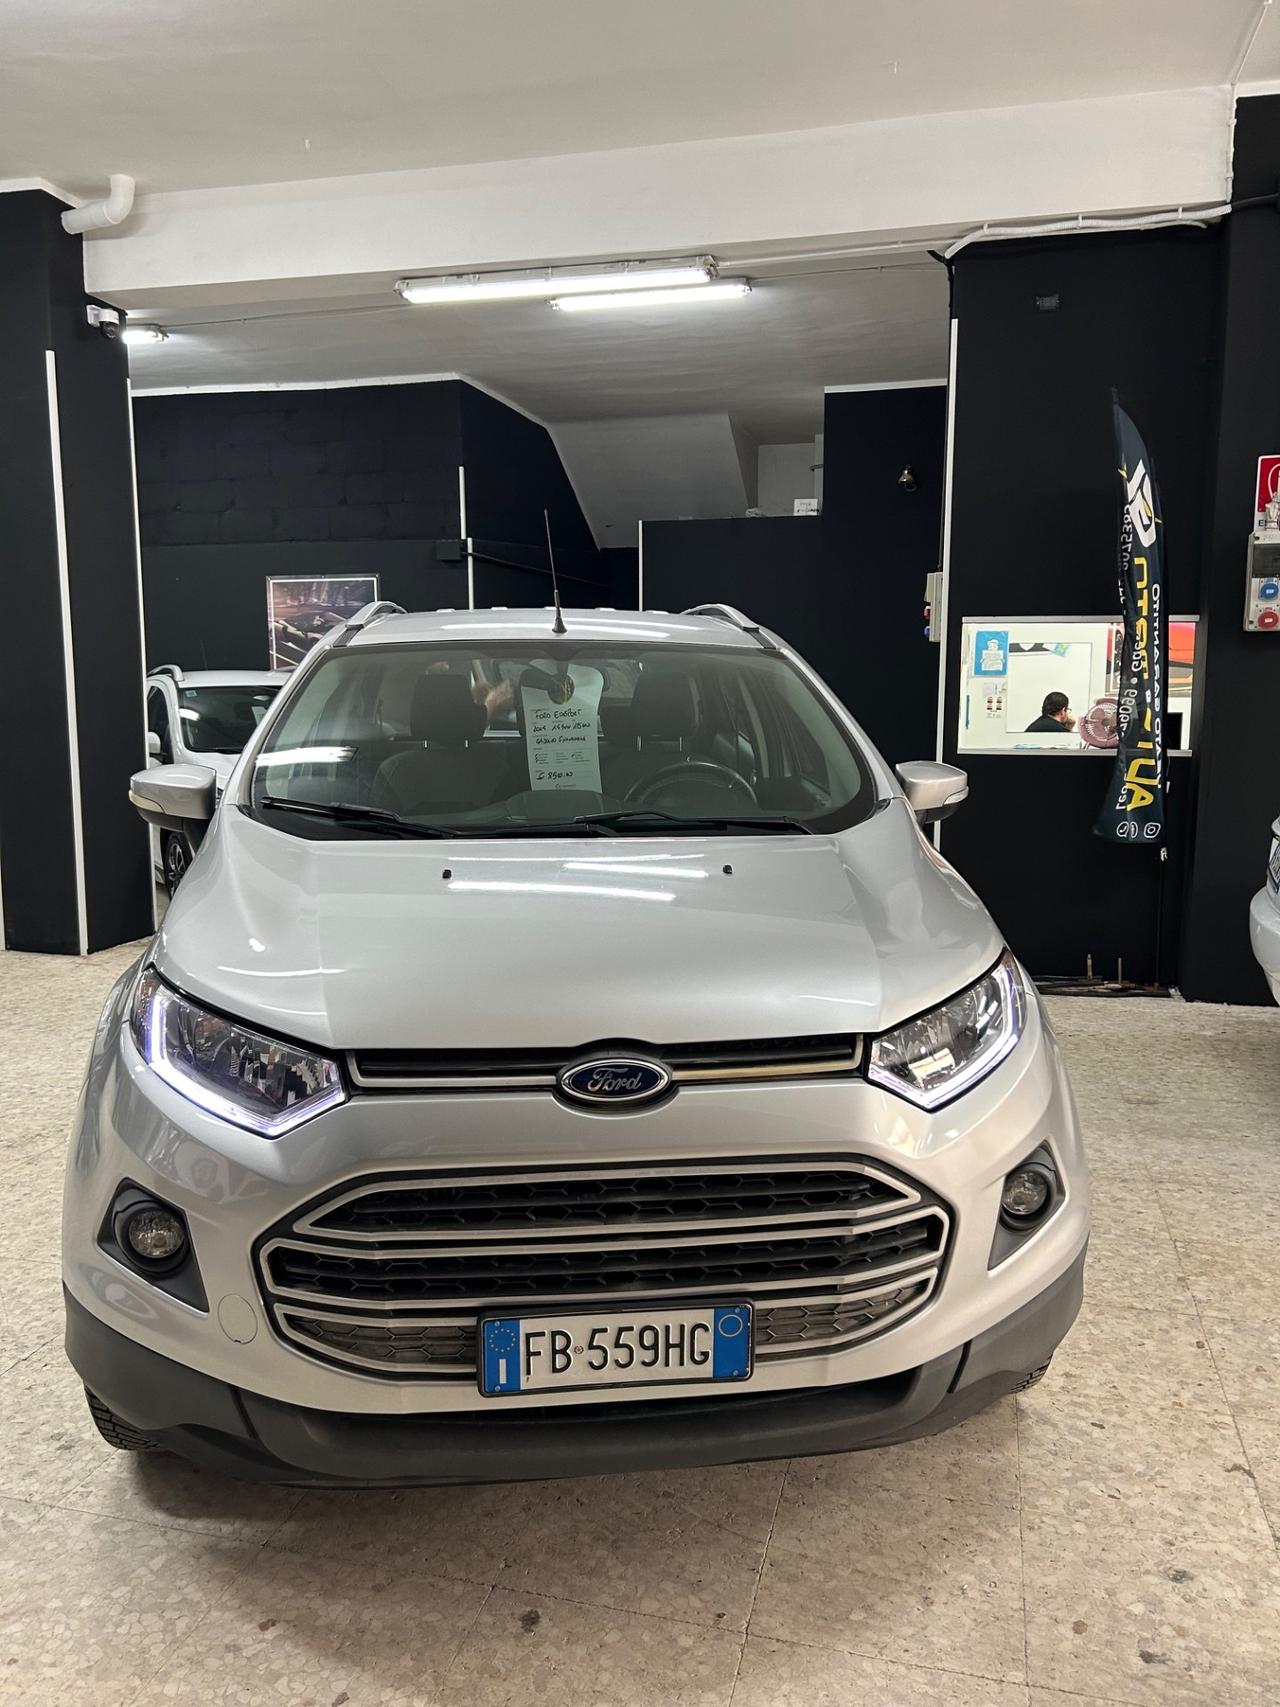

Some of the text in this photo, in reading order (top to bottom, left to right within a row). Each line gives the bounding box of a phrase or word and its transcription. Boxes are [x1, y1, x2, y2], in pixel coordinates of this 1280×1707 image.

[588, 1067, 641, 1092] Ford
[525, 1330, 572, 1376] FB
[588, 1323, 711, 1371] 559HG
